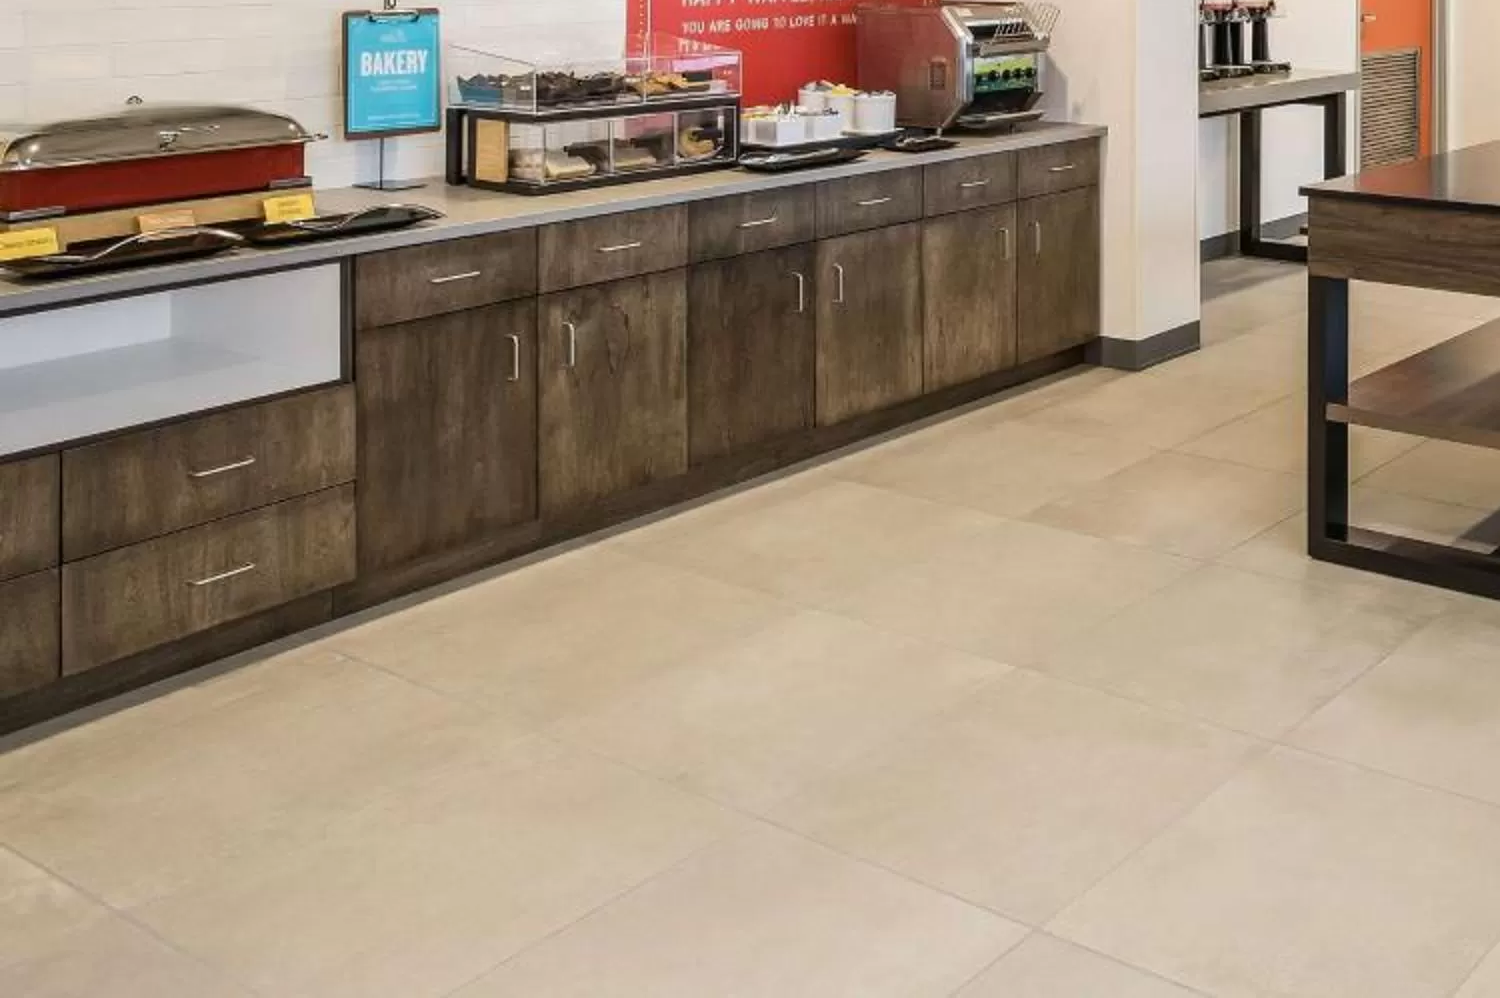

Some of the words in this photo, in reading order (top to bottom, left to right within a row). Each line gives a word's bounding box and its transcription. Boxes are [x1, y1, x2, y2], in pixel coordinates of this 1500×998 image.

[682, 20, 705, 34] YOU
[709, 18, 732, 33] ARE
[735, 17, 769, 31] GOING
[789, 14, 815, 28] LOVE
[360, 49, 429, 77] BAKERY
